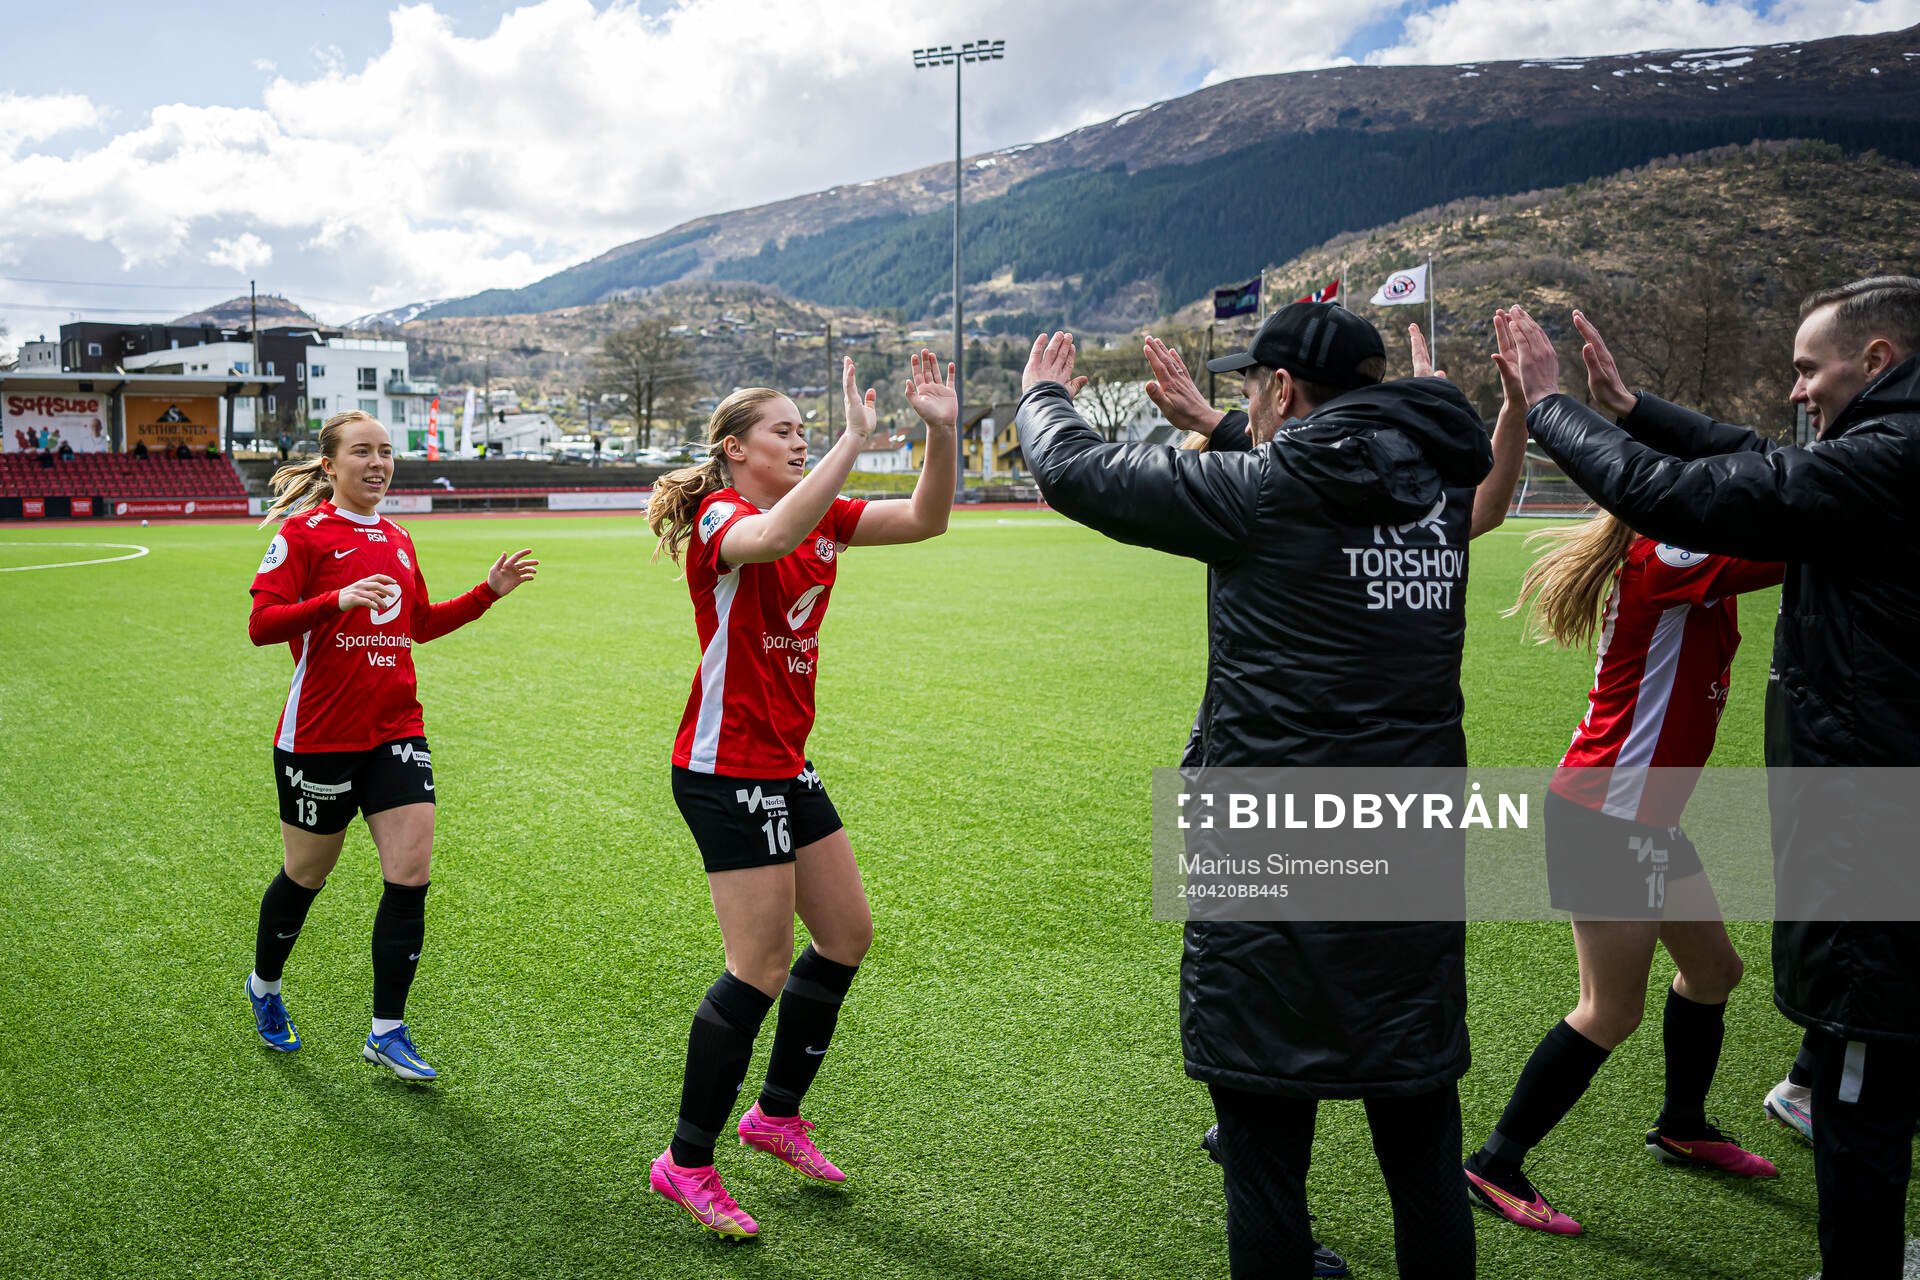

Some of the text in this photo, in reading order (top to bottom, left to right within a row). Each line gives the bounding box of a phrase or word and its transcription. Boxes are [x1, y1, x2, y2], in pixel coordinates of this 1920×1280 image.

[367, 533, 388, 543] RSM
[1342, 548, 1464, 578] TORSHOV
[1366, 580, 1454, 610] SPORT
[367, 651, 397, 667] Vest
[296, 798, 318, 827] 13
[761, 817, 791, 855] 16
[1646, 872, 1665, 908] 19
